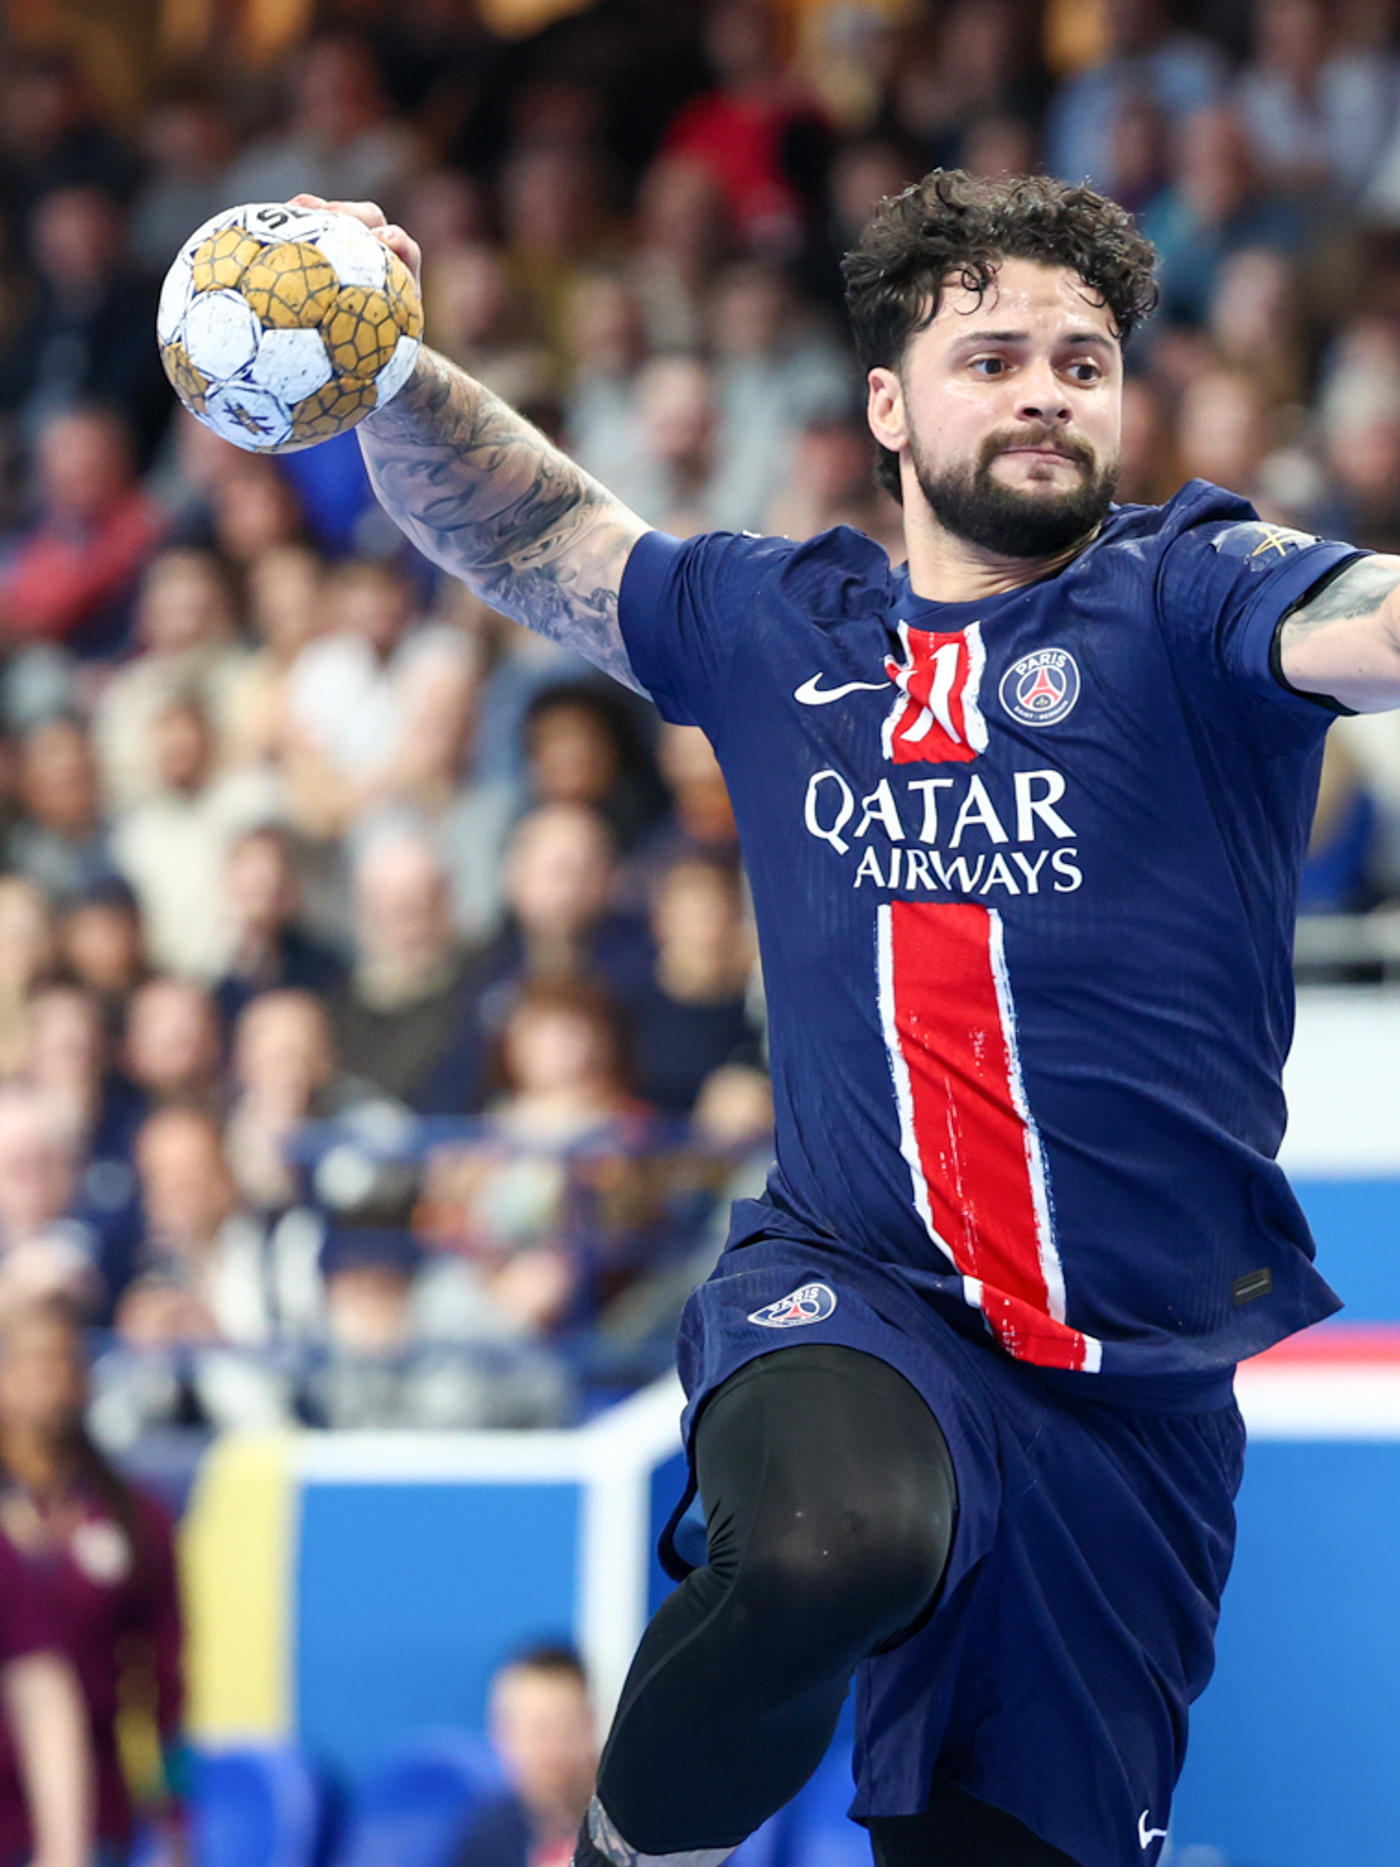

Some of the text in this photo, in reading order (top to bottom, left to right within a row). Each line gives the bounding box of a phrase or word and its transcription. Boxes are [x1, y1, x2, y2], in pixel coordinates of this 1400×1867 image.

[1015, 652, 1067, 676] PARIS
[804, 769, 1077, 855] QATAR
[853, 845, 1083, 896] AIRWAYS
